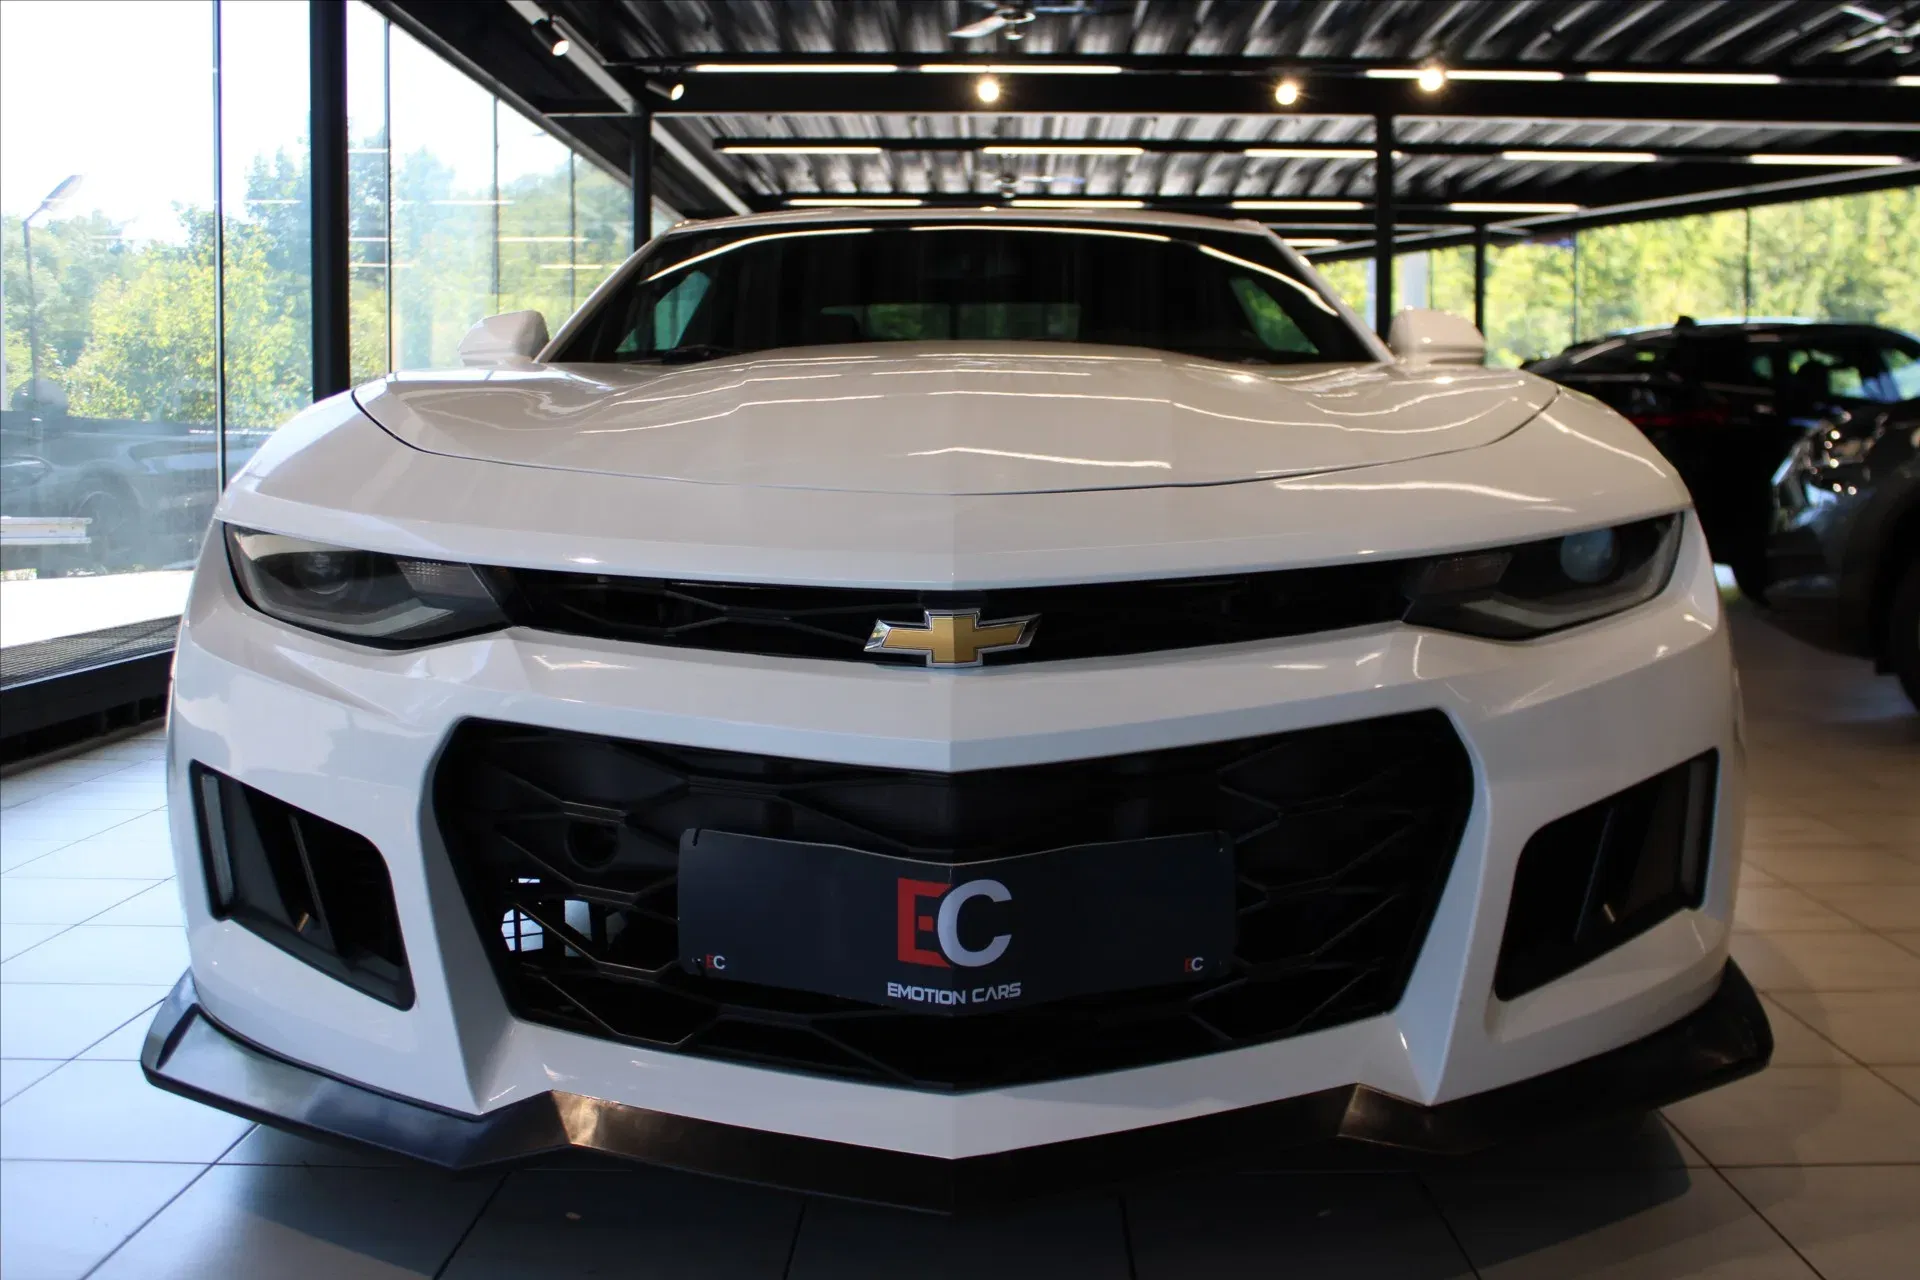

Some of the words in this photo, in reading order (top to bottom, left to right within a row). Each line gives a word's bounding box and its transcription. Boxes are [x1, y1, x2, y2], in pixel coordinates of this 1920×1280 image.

[897, 877, 1012, 967] EC
[705, 954, 726, 970] EC
[1184, 956, 1204, 972] EC
[887, 981, 966, 1006] EMOTION
[971, 981, 1022, 1004] CARS
